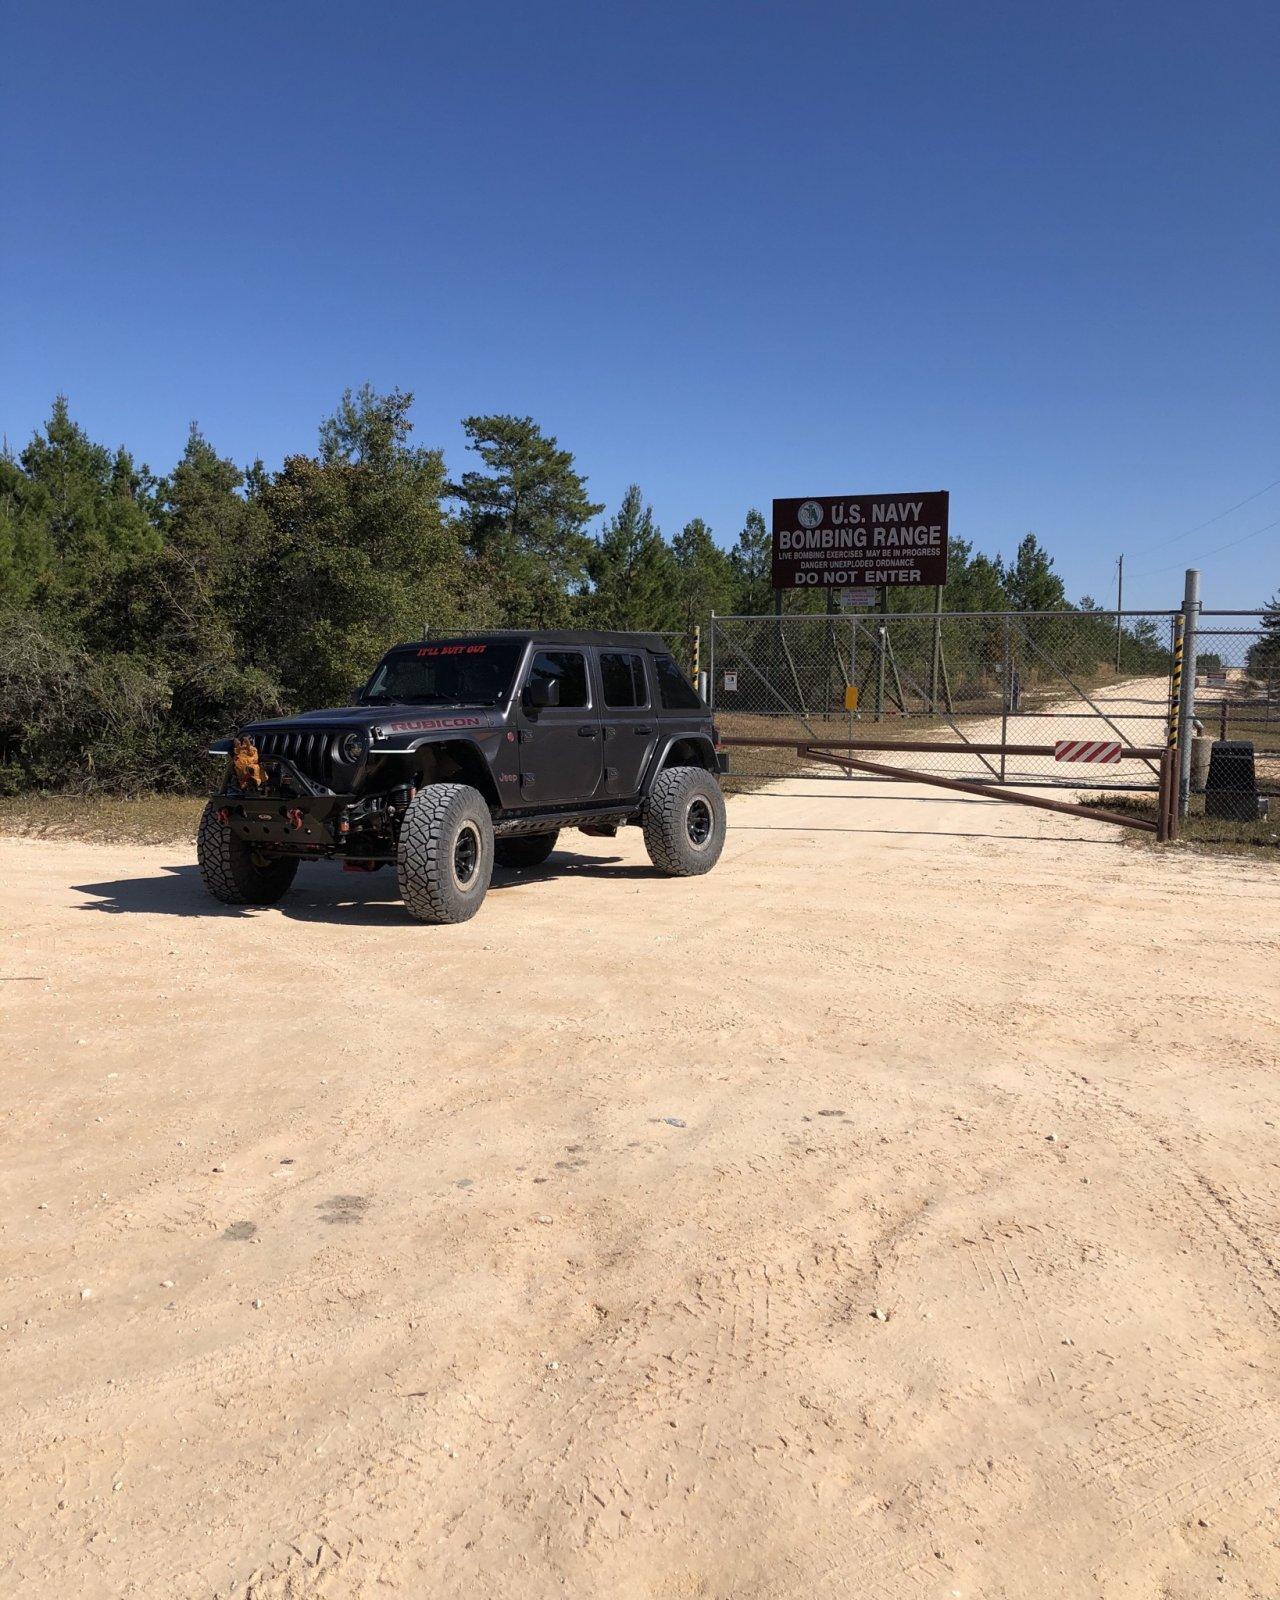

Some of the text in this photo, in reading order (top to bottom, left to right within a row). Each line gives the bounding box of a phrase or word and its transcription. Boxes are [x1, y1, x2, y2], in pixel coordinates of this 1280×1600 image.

[831, 502, 923, 524] U.S. NAVY
[779, 526, 941, 549] BOMBING RANGE
[779, 552, 793, 560] LIVE
[794, 551, 825, 559] BOMBING
[826, 550, 863, 558] EXERCISES
[902, 548, 941, 556] PROGRESS
[801, 559, 914, 569] DANGER UNEXPLODED ORDNANCE
[795, 570, 921, 584] DO NOT ENTER
[467, 645, 487, 654] OUT
[391, 718, 480, 731] RUBICON
[499, 773, 518, 782] Jeep
